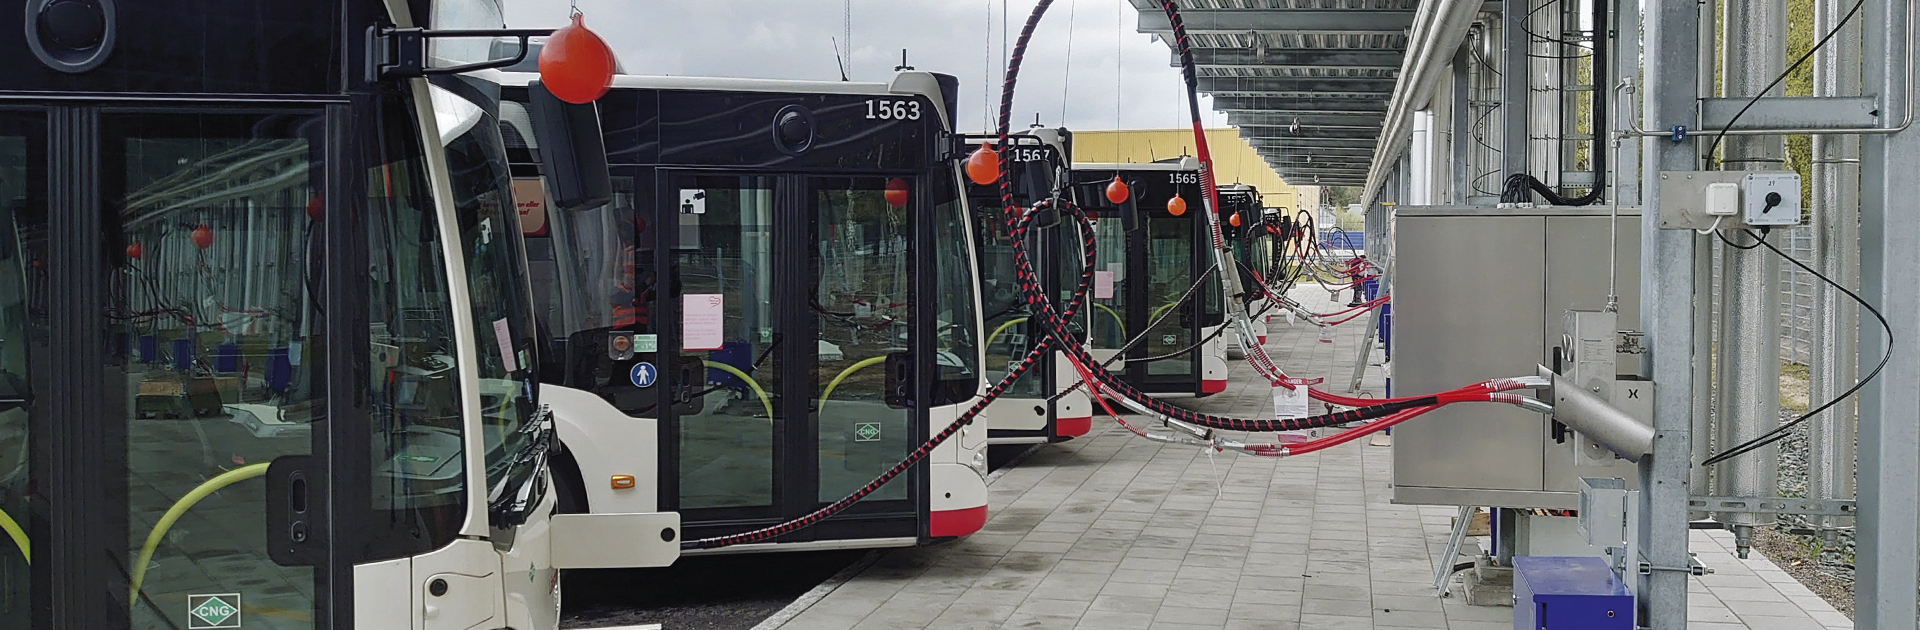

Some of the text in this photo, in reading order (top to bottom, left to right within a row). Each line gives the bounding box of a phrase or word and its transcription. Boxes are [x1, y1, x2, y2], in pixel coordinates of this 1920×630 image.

[866, 99, 920, 120] 1563
[1014, 149, 1050, 162] 1567
[1169, 173, 1197, 184] 1565
[860, 428, 876, 436] CNG
[199, 605, 230, 617] CNG
